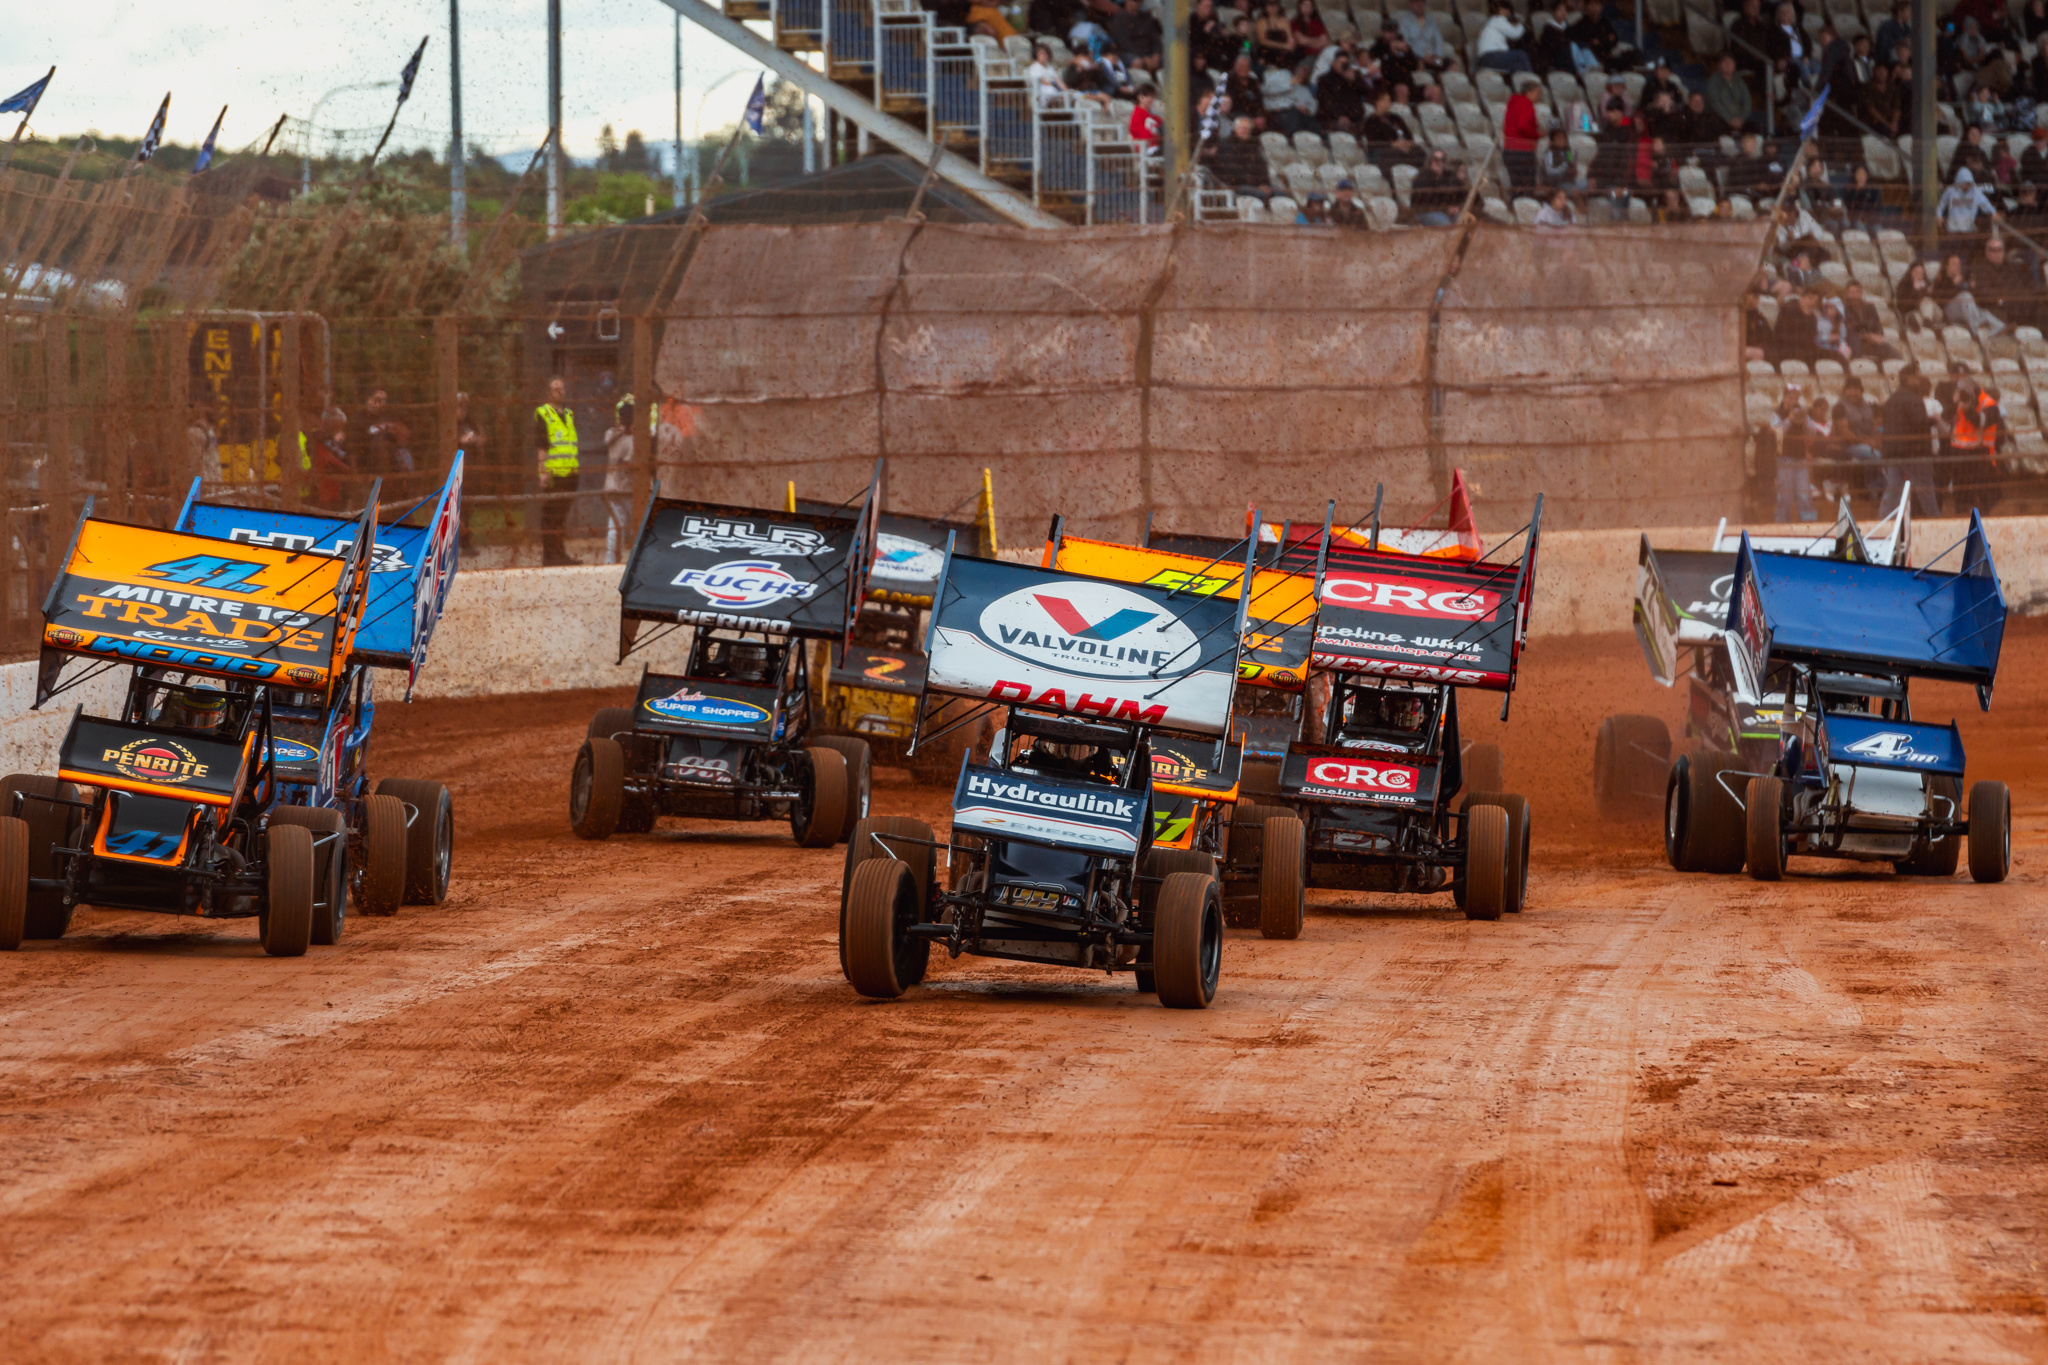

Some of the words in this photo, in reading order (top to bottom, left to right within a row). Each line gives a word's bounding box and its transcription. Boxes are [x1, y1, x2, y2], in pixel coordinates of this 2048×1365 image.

[681, 515, 825, 547] HLR
[679, 571, 809, 597] FUCHS
[1322, 578, 1485, 616] CRC
[99, 584, 245, 617] MITRE
[77, 594, 326, 652] TRADE
[677, 608, 792, 635] HERMO
[1318, 624, 1407, 643] peline
[47, 630, 84, 642] PENRITE
[132, 630, 249, 649] Racing
[998, 623, 1172, 669] VALVOLINE
[90, 635, 281, 679] WOOD
[1051, 652, 1119, 668] TRUSTED
[1314, 637, 1483, 663] ww.hoseshop.co.nz
[287, 667, 324, 682] PENRITE
[863, 656, 907, 685] 2
[655, 701, 697, 712] SUPER
[701, 706, 760, 719] SHOPPES
[986, 679, 1170, 725] DAHM
[102, 748, 209, 778] PENRITE
[1313, 763, 1411, 789] CRC
[967, 775, 1133, 817] Hydraulink
[1300, 786, 1369, 798] pipeline
[105, 829, 183, 859] 41
[1010, 822, 1116, 843] ENERGY
